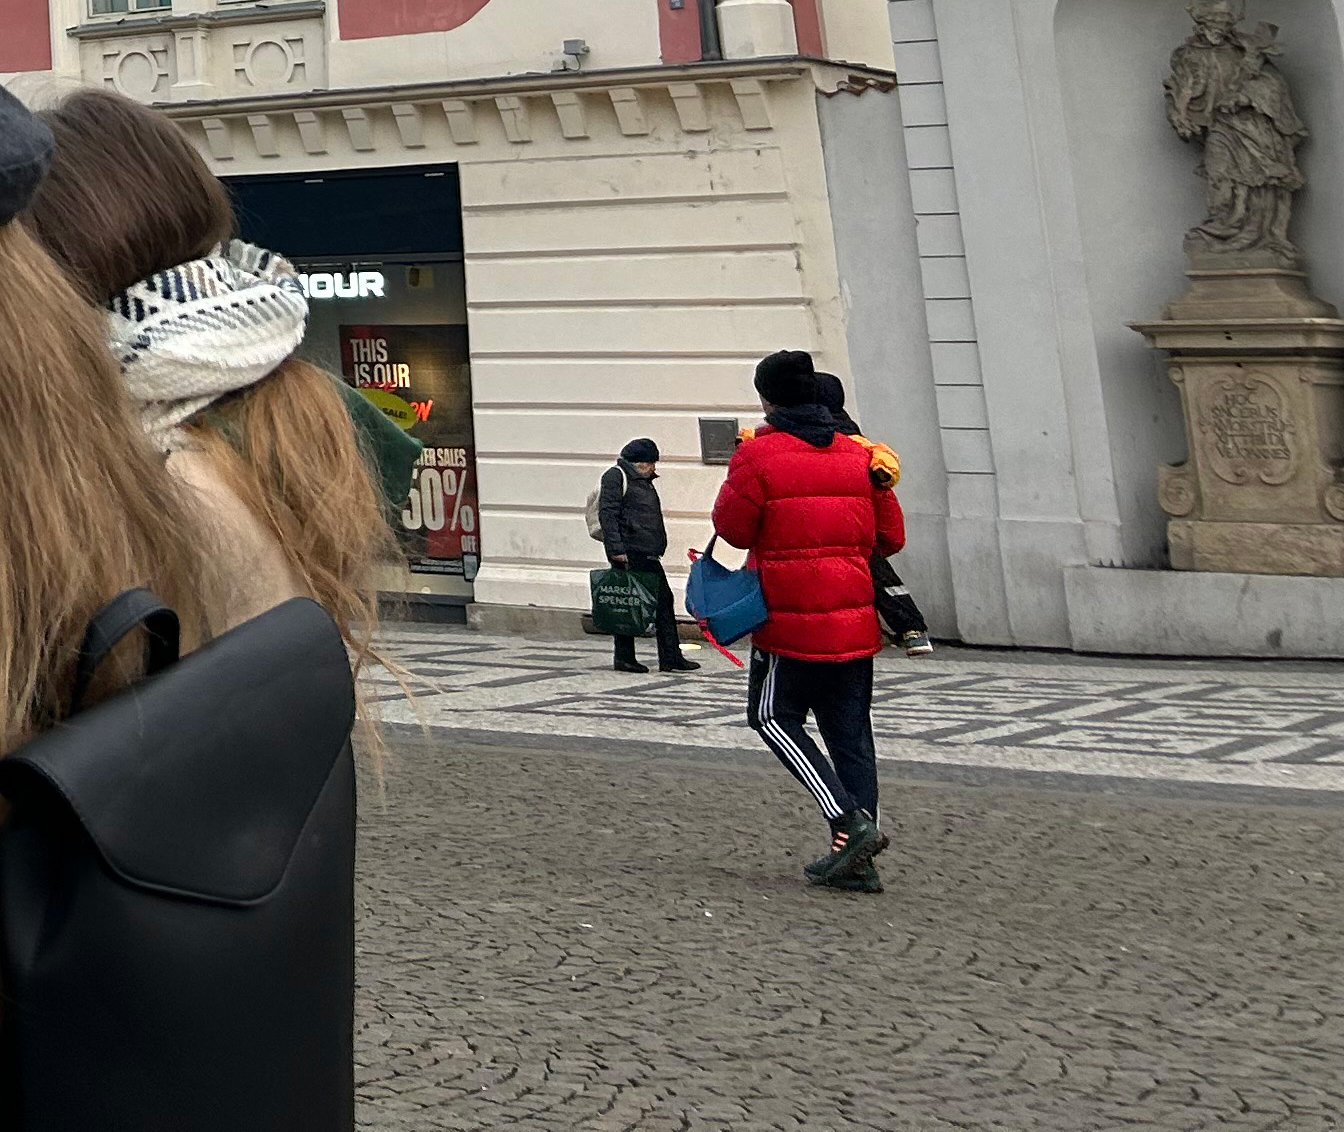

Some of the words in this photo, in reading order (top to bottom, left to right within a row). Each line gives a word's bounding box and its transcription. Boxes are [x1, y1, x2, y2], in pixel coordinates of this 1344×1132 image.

[350, 338, 388, 363] THIS
[354, 363, 372, 388] IS
[373, 363, 411, 388] OUR
[436, 448, 467, 467] SALES
[461, 535, 476, 552] OFF
[598, 585, 630, 595] MARKS
[598, 595, 641, 606] SPENCER
